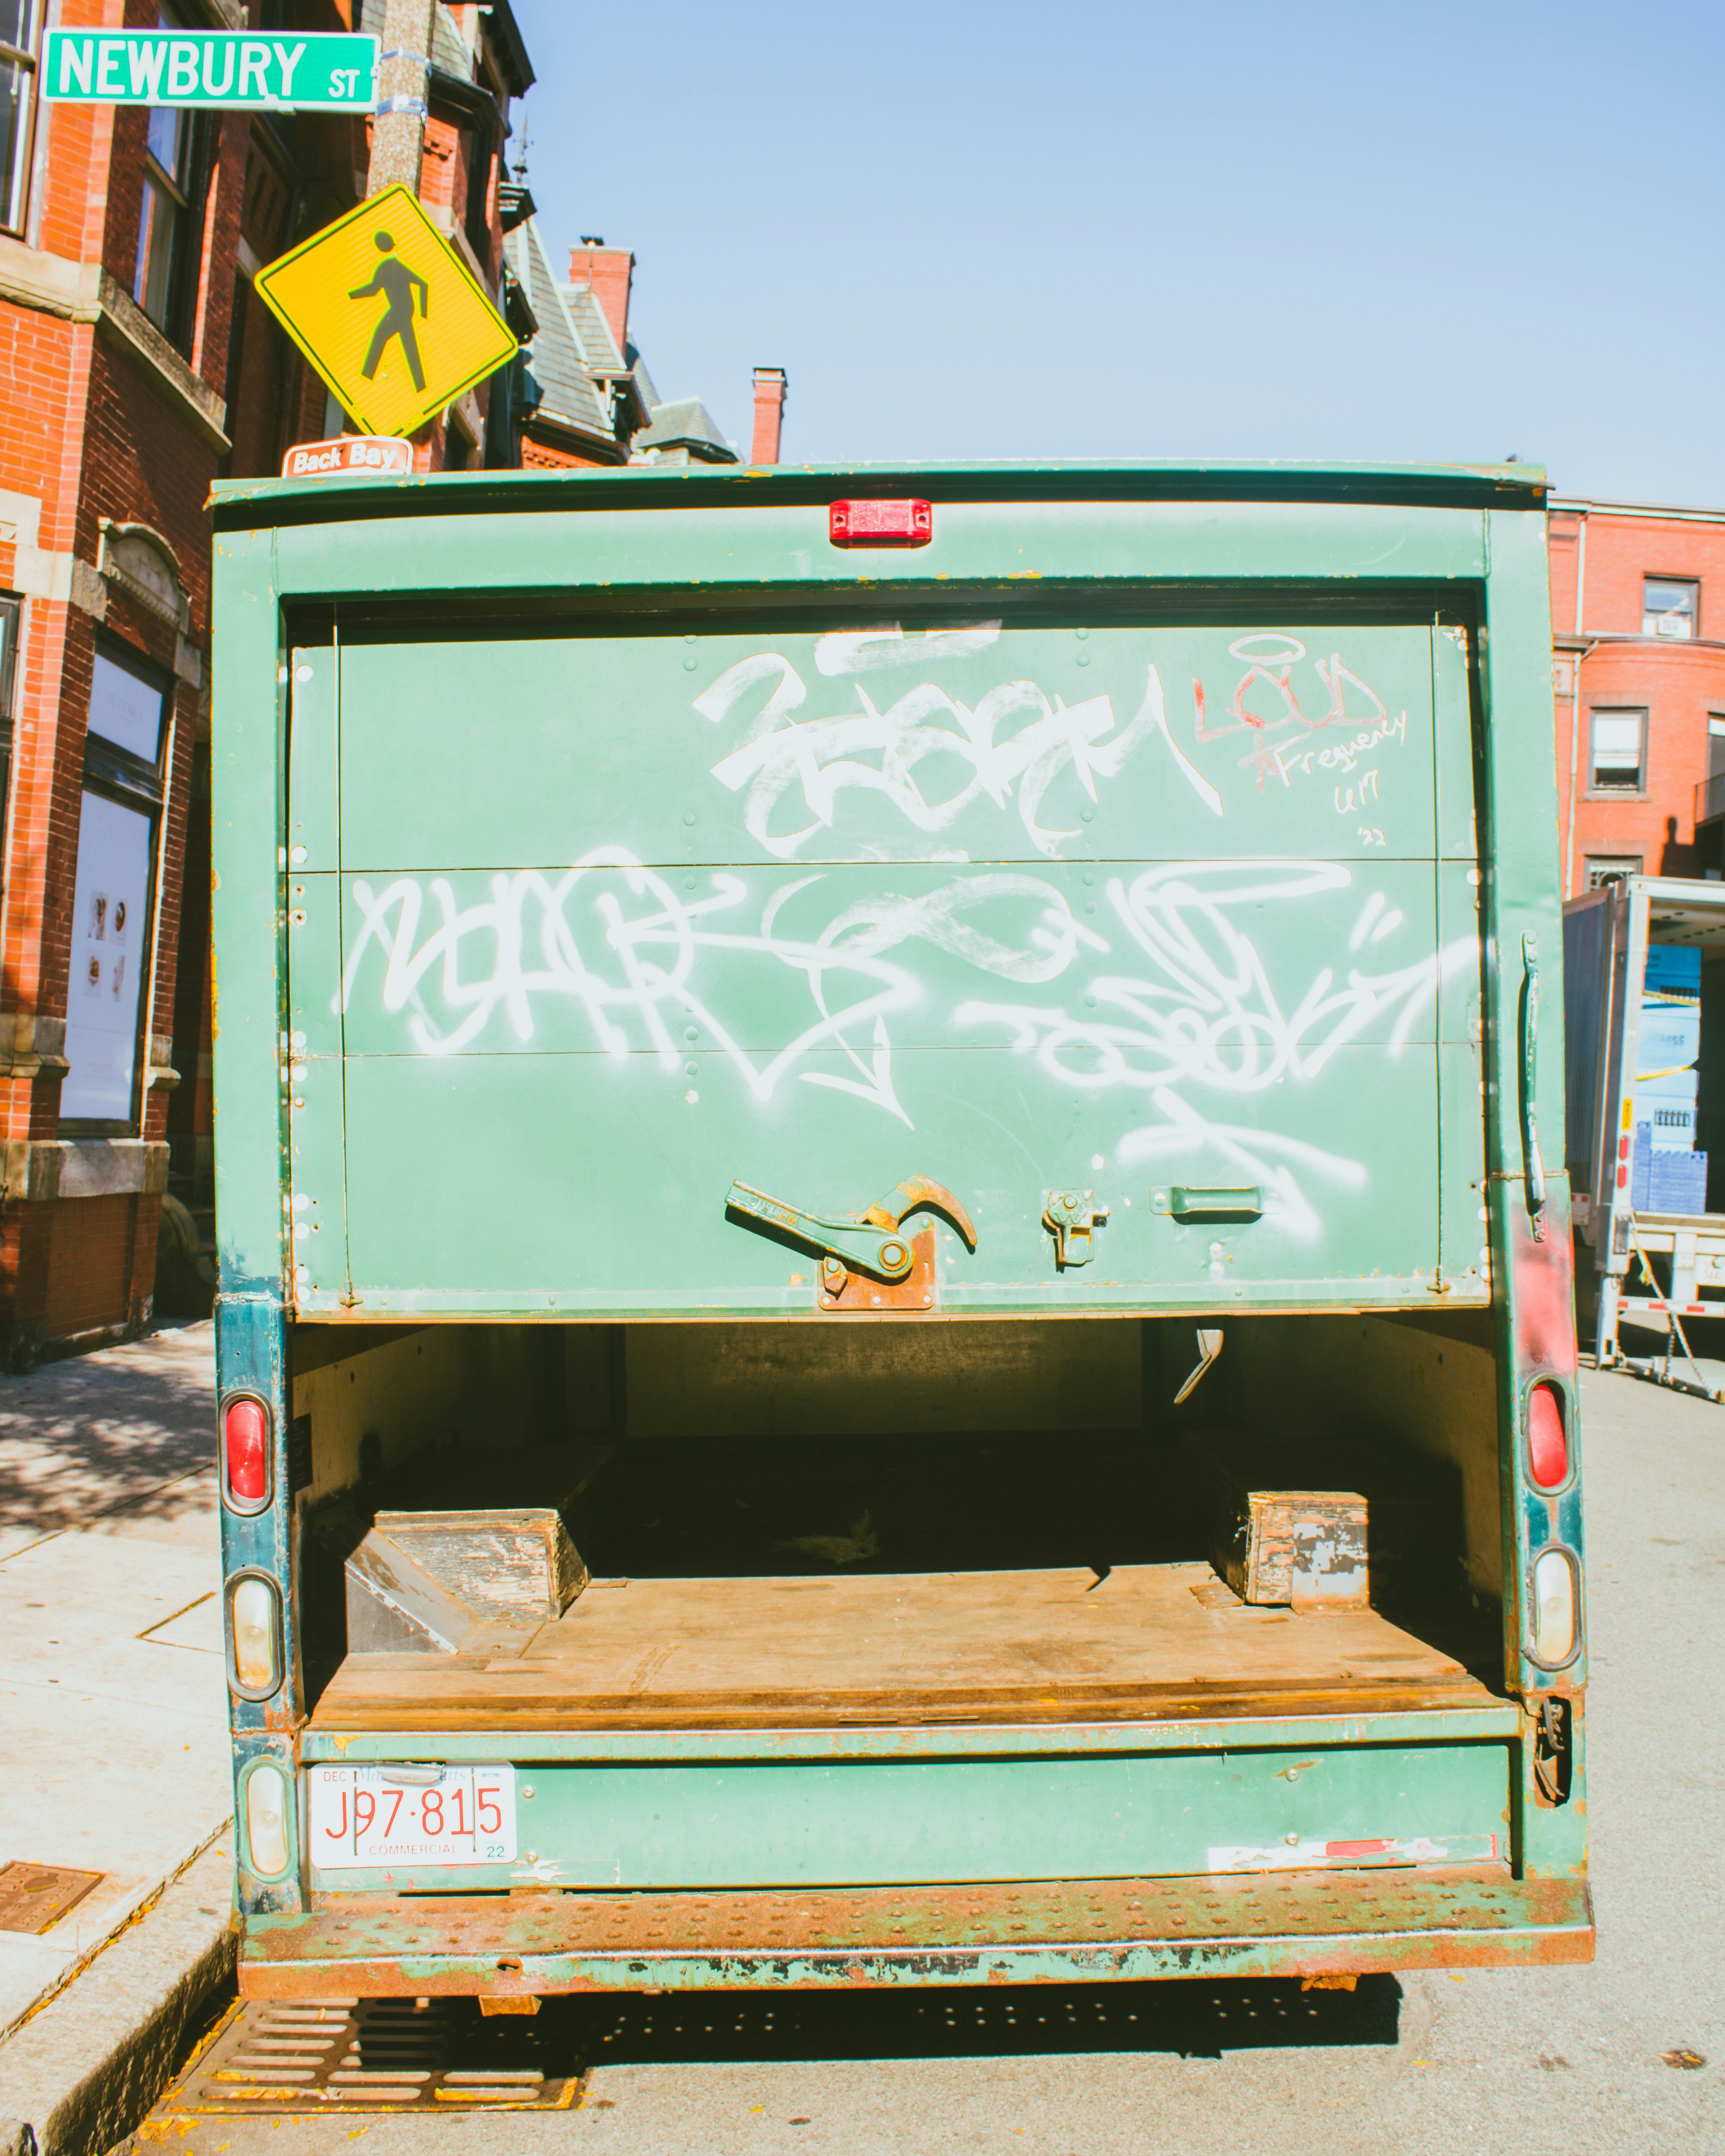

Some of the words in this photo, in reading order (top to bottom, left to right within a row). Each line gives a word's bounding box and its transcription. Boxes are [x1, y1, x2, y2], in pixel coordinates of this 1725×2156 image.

[59, 39, 307, 96] NEWBURY
[328, 69, 360, 98] ST
[293, 447, 342, 473] Back
[350, 443, 397, 469] Bay
[1192, 652, 1387, 744] LOUD
[324, 1771, 346, 1782] DEC
[370, 1844, 459, 1855] COMMERCIAL
[487, 1846, 505, 1858] 22
